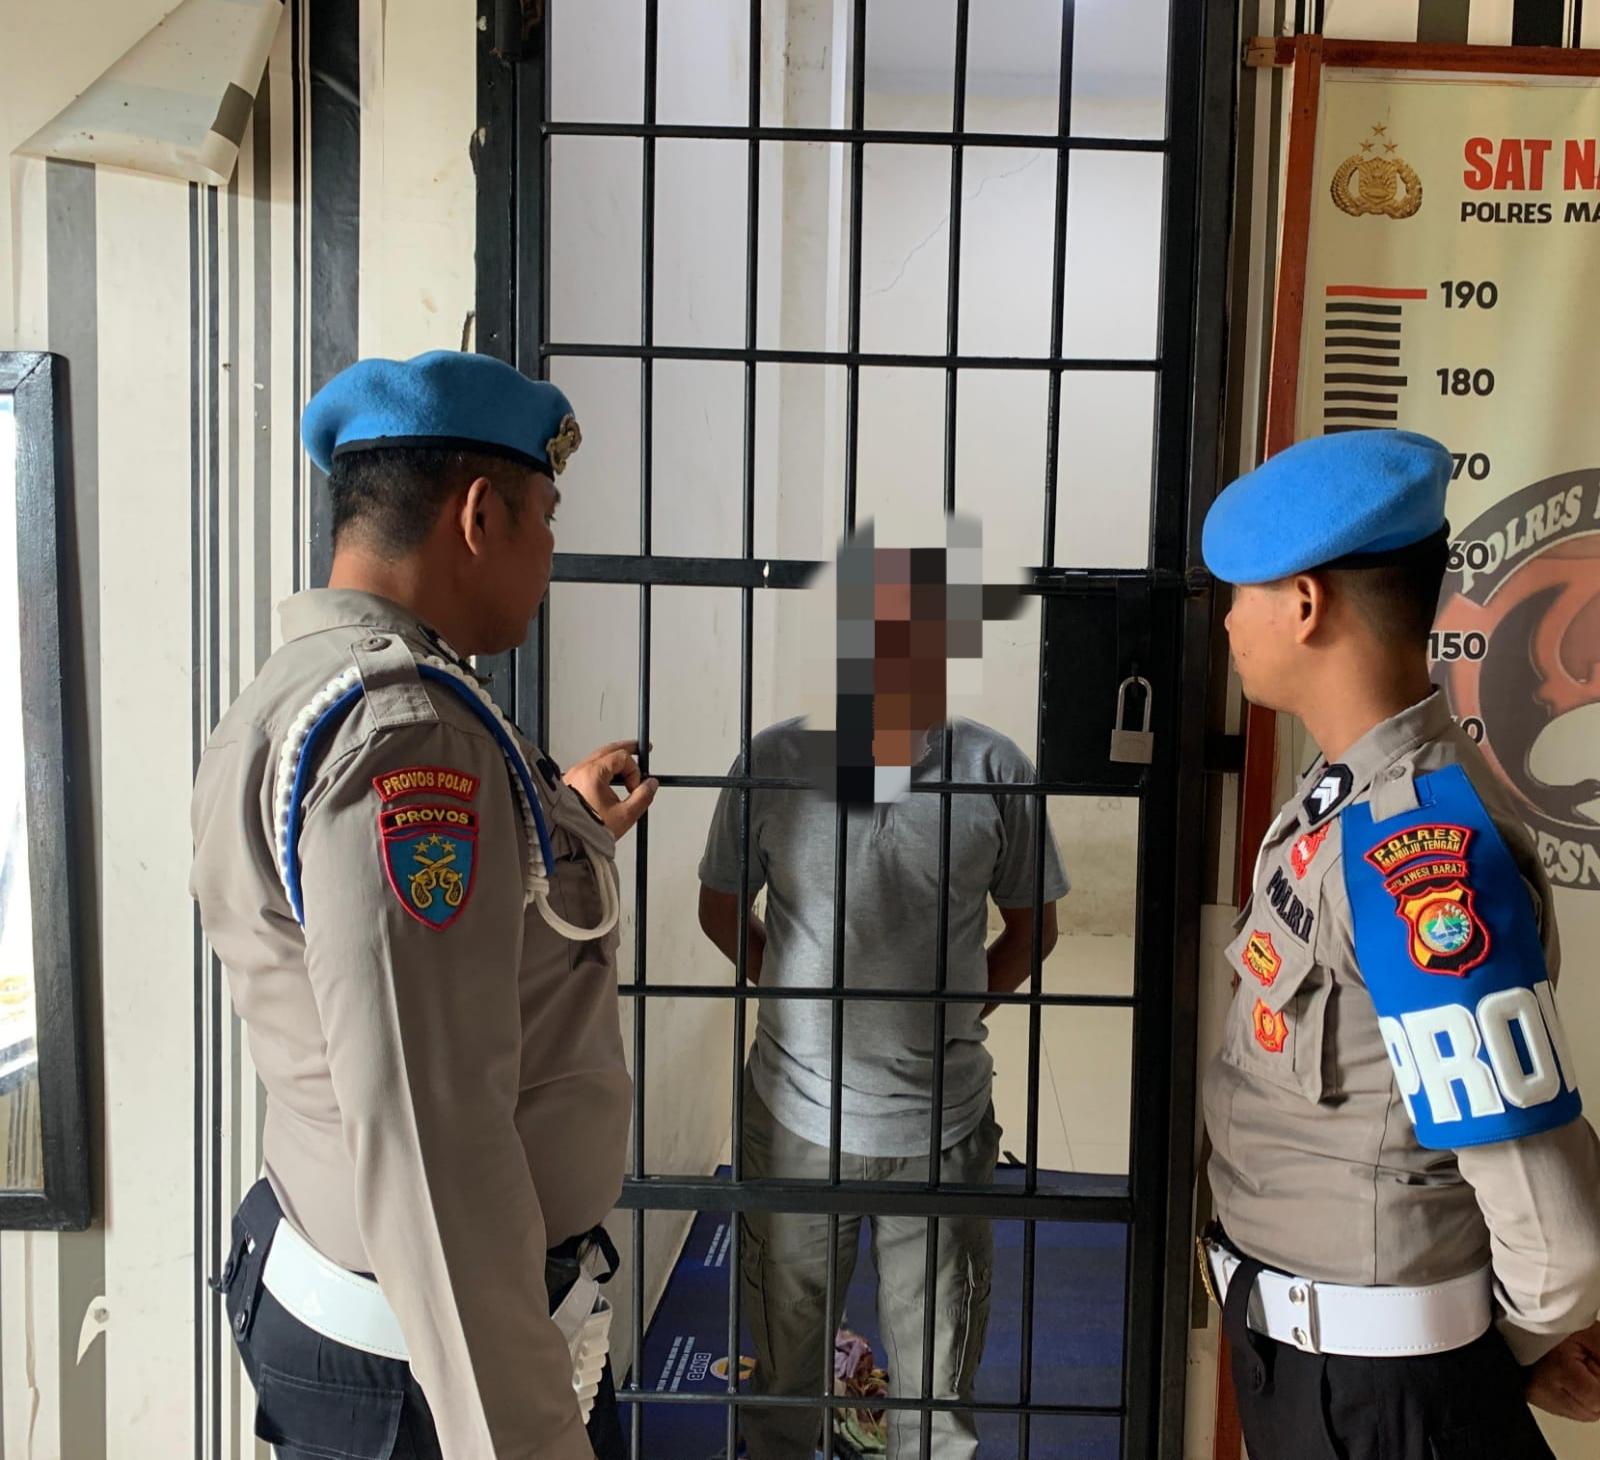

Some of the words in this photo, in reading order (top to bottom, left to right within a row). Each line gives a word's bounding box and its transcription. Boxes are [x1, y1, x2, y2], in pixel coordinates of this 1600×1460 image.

[1463, 137, 1552, 191] SAT
[1461, 202, 1552, 224] POLRES
[1441, 281, 1498, 309] 190
[1437, 368, 1495, 396] 180
[1451, 452, 1490, 480] 70
[1447, 542, 1489, 571] 60
[1429, 631, 1487, 660] 150
[382, 771, 435, 796] PROVOS
[438, 772, 473, 796] POLRI
[395, 809, 469, 826] PROVOS
[1373, 829, 1463, 862] POLRES
[1266, 865, 1315, 944] POLRI
[687, 1353, 712, 1381] BNPB
